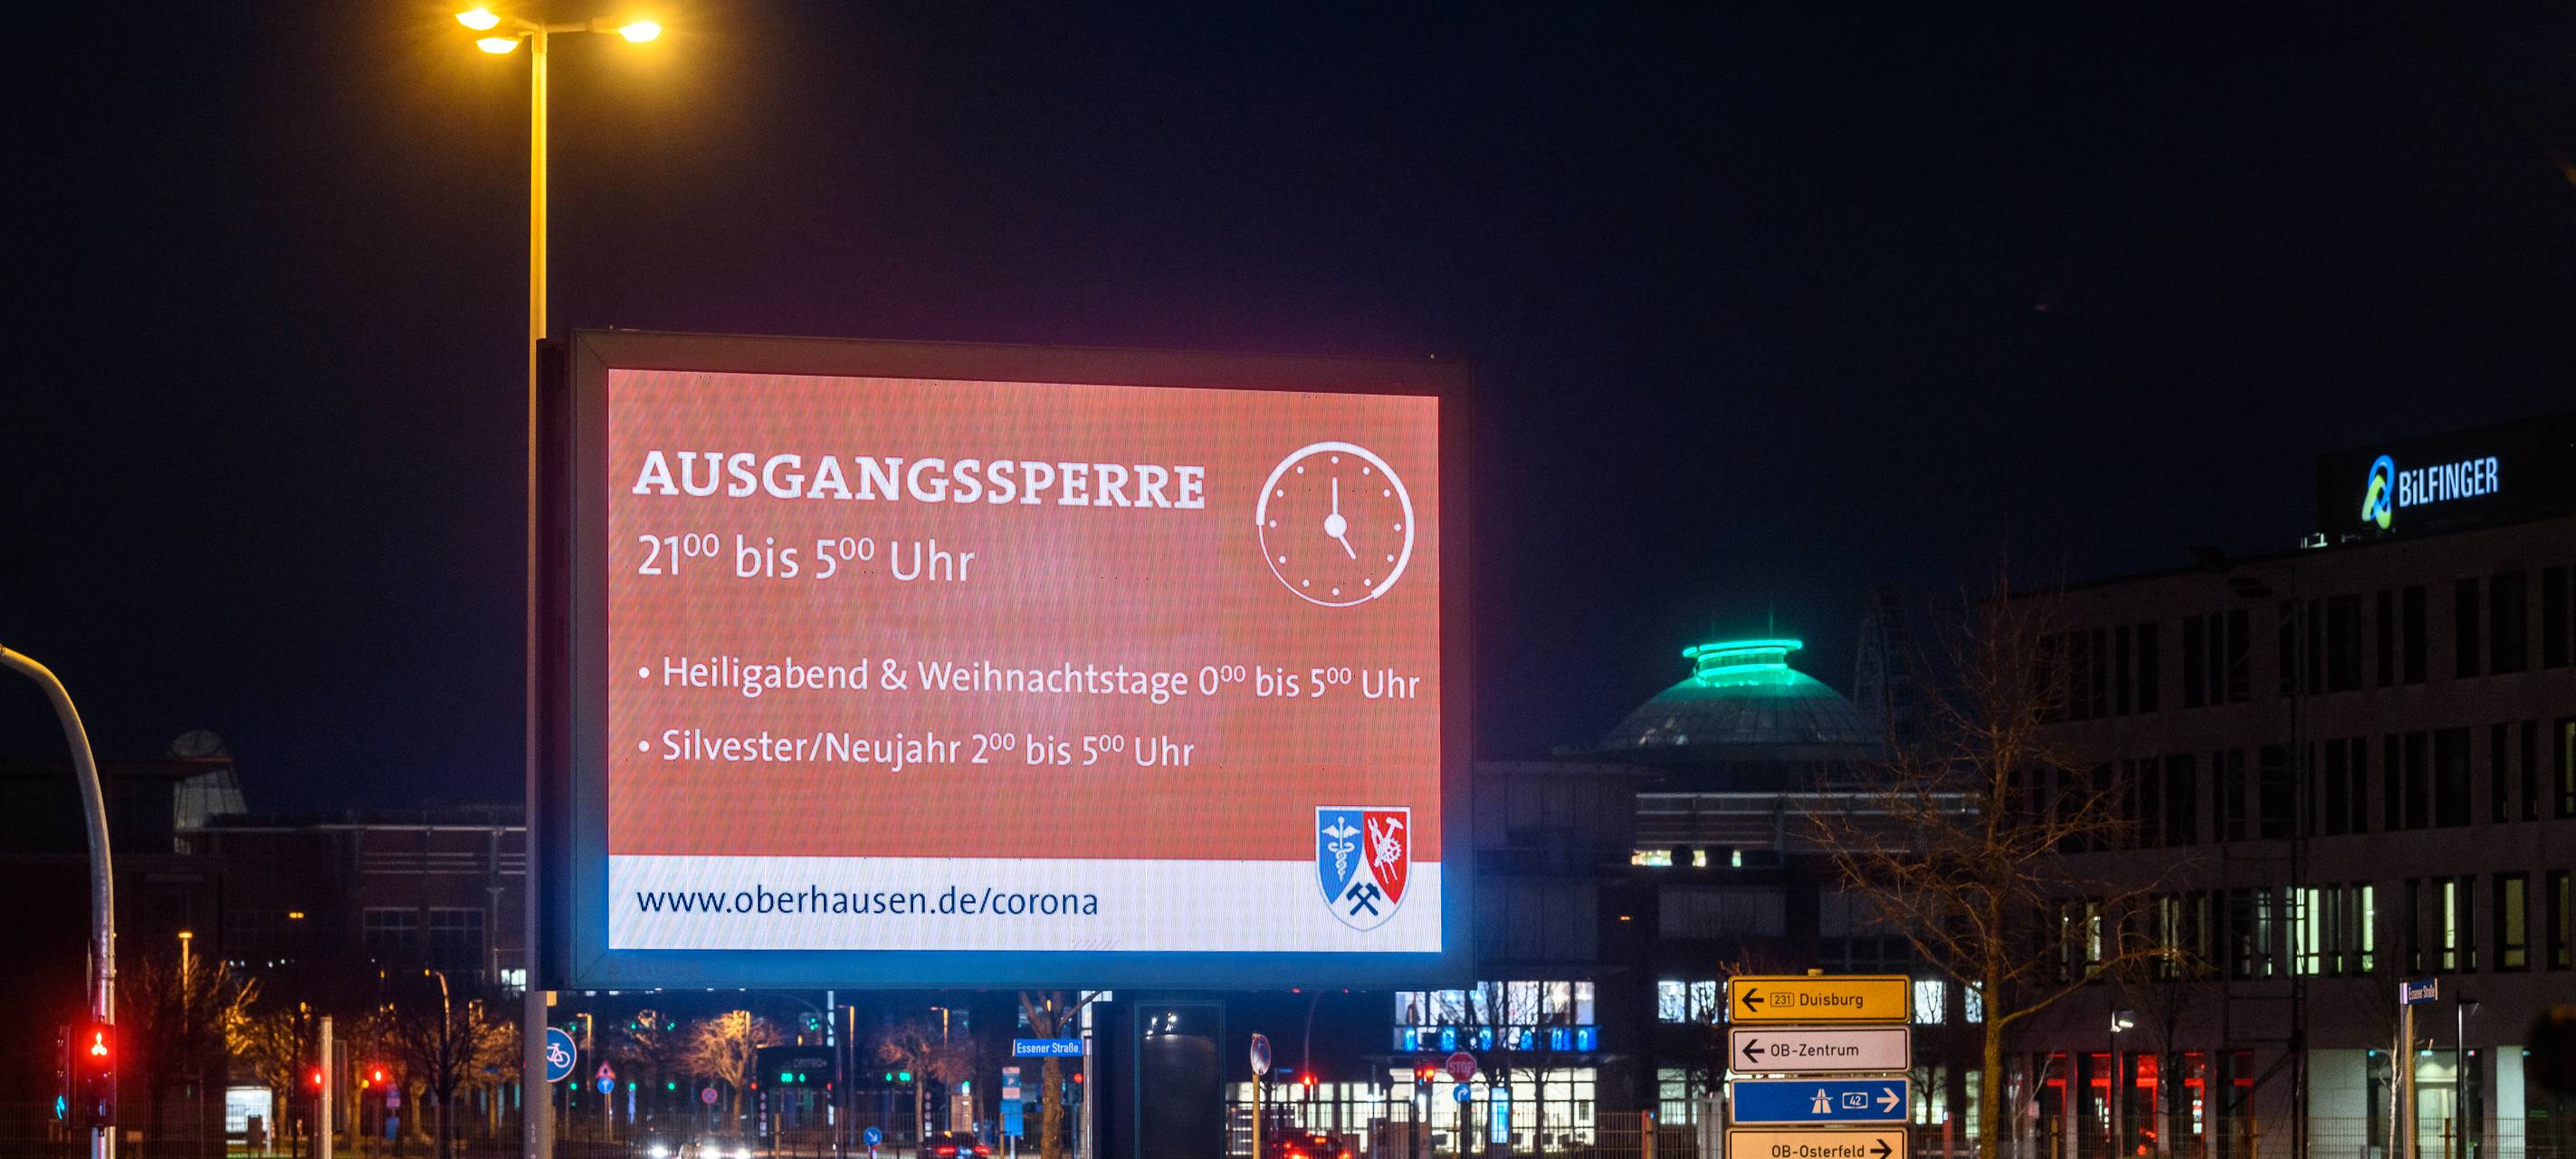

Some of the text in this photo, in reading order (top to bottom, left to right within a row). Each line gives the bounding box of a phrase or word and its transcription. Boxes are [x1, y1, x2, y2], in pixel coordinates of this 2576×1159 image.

[633, 450, 1205, 510] AUSGANGSSPERRE
[736, 534, 799, 579] bis
[891, 538, 976, 582] Uhr
[663, 656, 868, 699] Heiligabend
[880, 658, 908, 691] &
[918, 660, 1188, 704] Weihnachtstage
[1255, 666, 1301, 697] bis
[1362, 668, 1420, 699] Uhr
[663, 729, 960, 772] Silvester/Neujahr
[1026, 734, 1072, 766] bis
[1135, 736, 1195, 767] Uhr
[636, 884, 1099, 916] www.oberhausen.de/corona
[1774, 993, 1864, 1008] 231 Duisburg
[1016, 1042, 1079, 1054] Essener Straße
[1770, 1044, 1859, 1057] OB-Zentrum
[1449, 1061, 1474, 1073] STOP
[1849, 1096, 1861, 1106] 42
[1771, 1145, 1865, 1158] OB-Osterfeld
